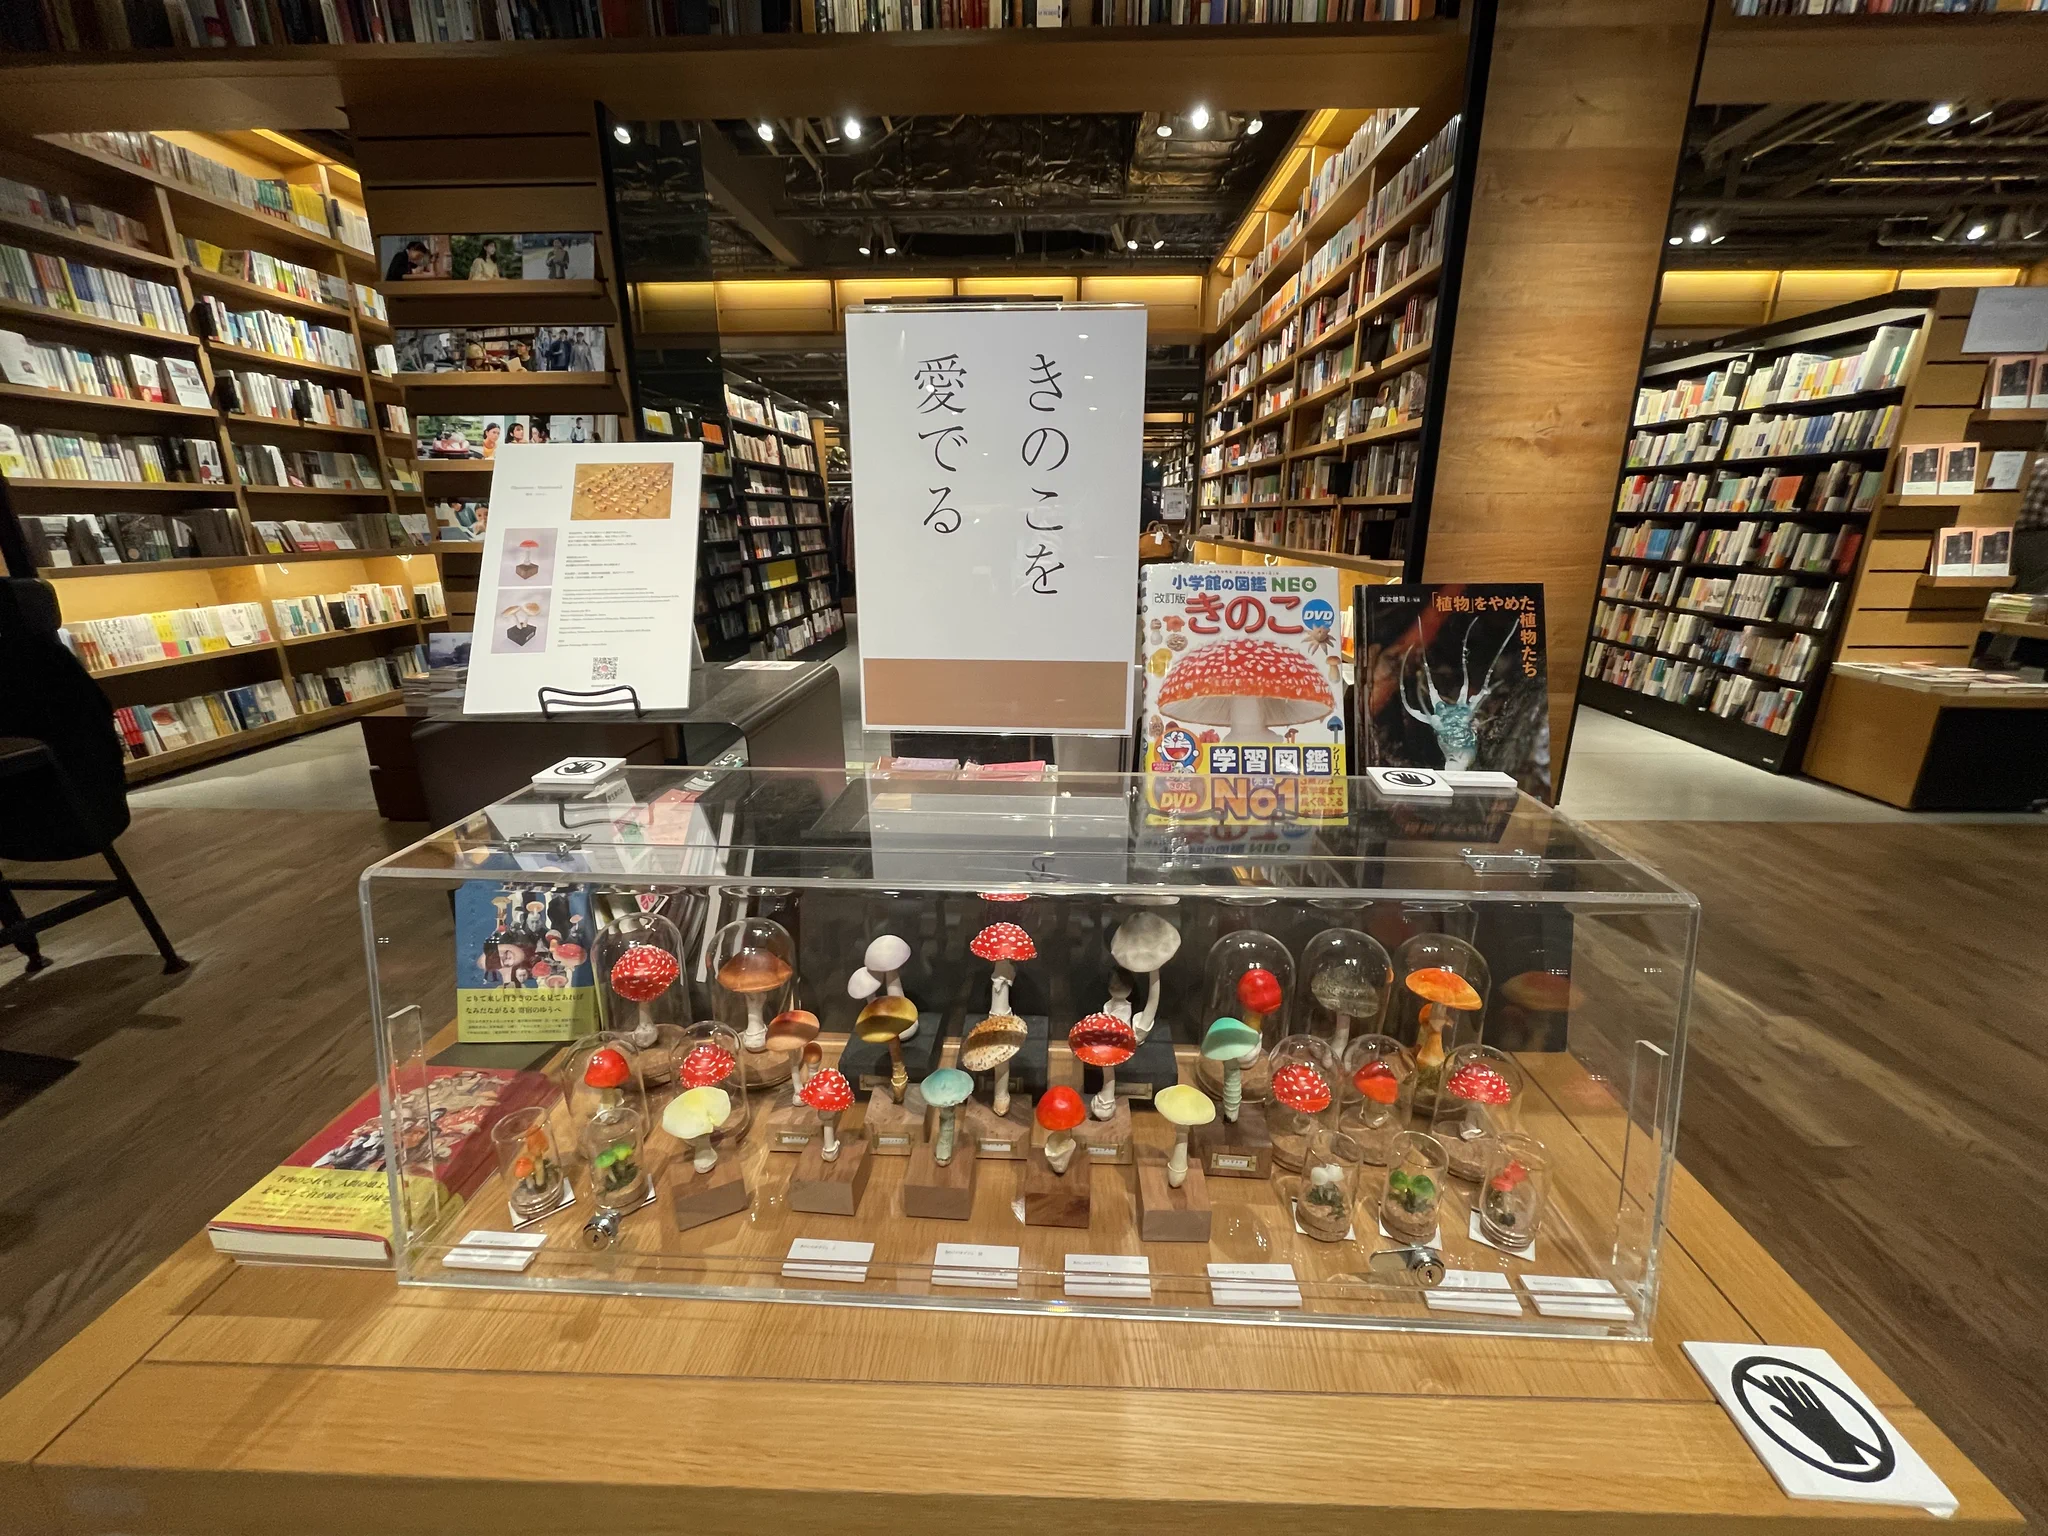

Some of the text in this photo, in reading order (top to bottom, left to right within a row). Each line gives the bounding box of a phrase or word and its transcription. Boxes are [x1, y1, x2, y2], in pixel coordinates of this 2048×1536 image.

[913, 353, 968, 535] 愛でる
[1021, 353, 1070, 595] きのこを
[1172, 574, 1317, 592] 小学館の図鑑 NEO
[1154, 592, 1186, 604] 改訂版
[1432, 591, 1535, 614] 「植物」をやめた
[1185, 592, 1304, 634] きのこ
[1303, 610, 1333, 620] DVD
[1520, 613, 1538, 678] 植物たち
[1211, 747, 1330, 773] 学習図鑑
[1160, 792, 1198, 808] DVD
